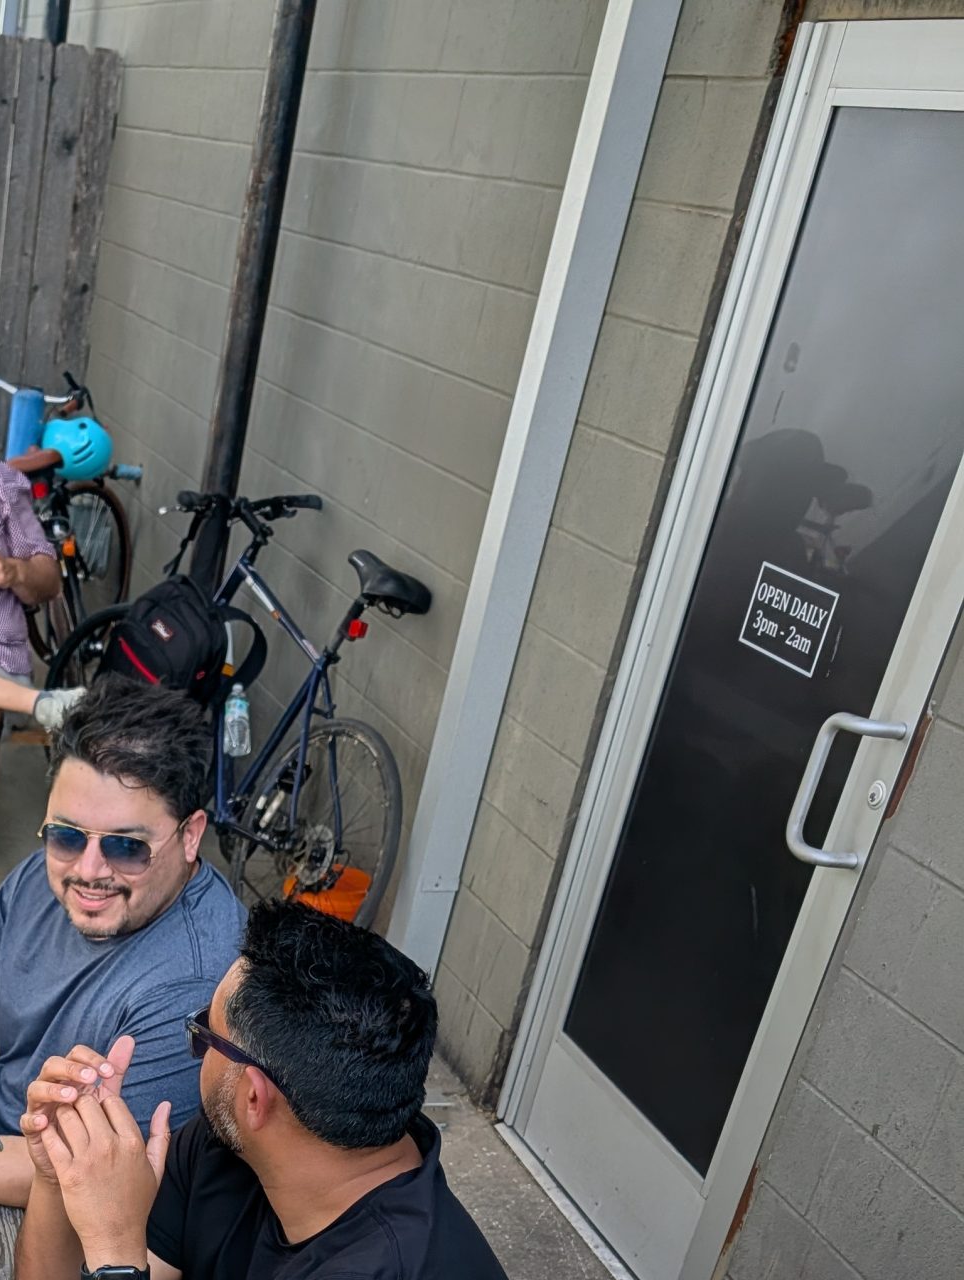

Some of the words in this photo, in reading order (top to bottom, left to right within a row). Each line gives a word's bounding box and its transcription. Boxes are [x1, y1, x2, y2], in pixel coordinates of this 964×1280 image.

[757, 582, 791, 613] OPEN
[789, 597, 827, 628] DAILY
[752, 610, 778, 637] 3pm
[785, 626, 811, 654] 2am
